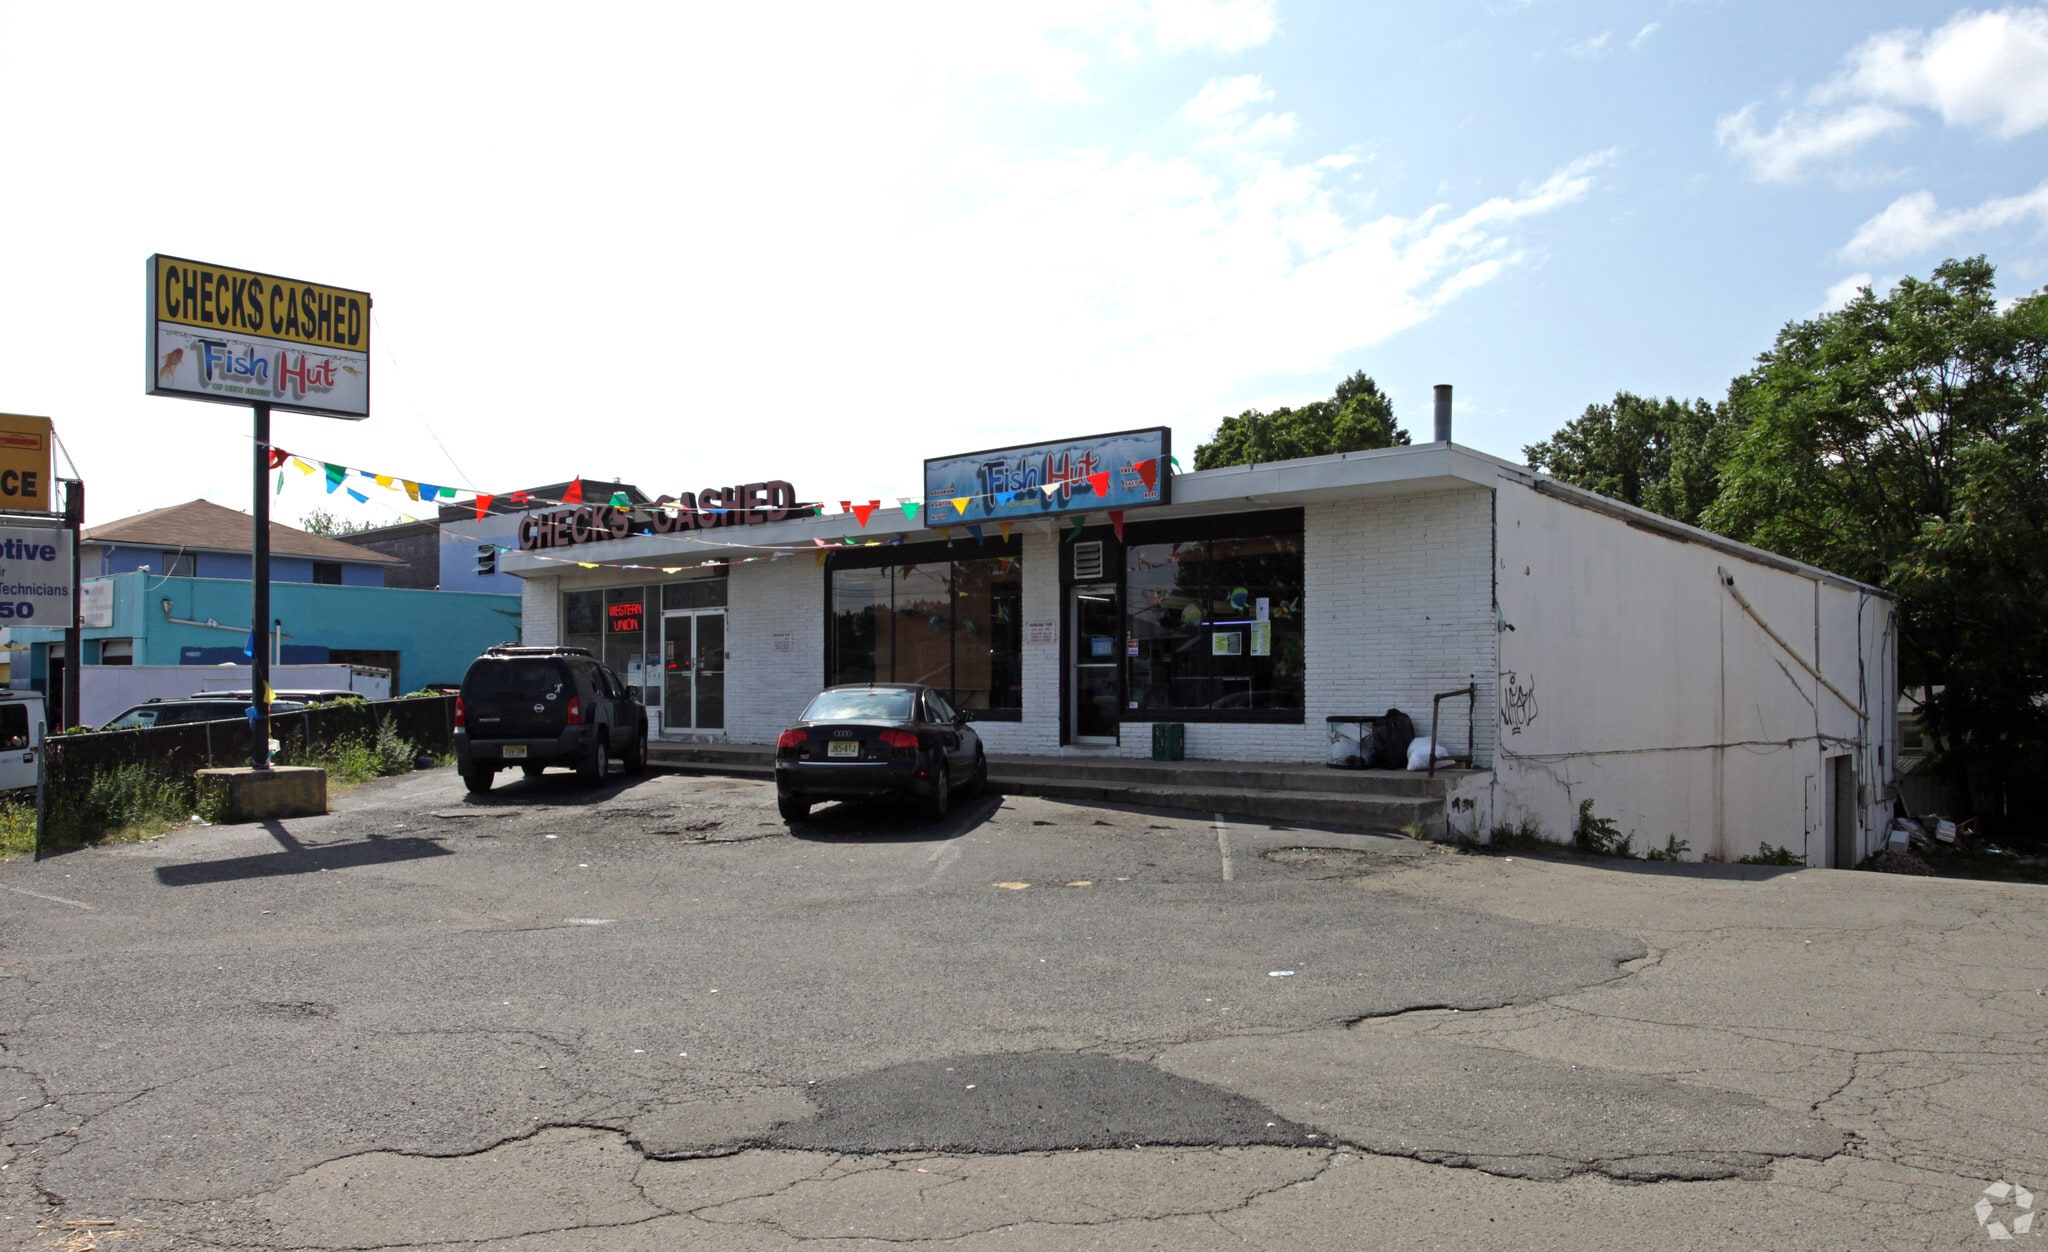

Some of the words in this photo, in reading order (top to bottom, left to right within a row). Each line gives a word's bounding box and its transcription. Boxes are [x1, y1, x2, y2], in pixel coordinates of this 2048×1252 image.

[198, 339, 269, 381] Fish
[279, 351, 338, 394] Hut
[1, 469, 37, 497] CE
[981, 455, 1038, 508] Fish
[1044, 449, 1100, 499] Hut
[518, 505, 632, 550] CHECKS
[652, 480, 796, 533] CASHED
[609, 603, 642, 616] WESTERN
[614, 619, 638, 631] UNION
